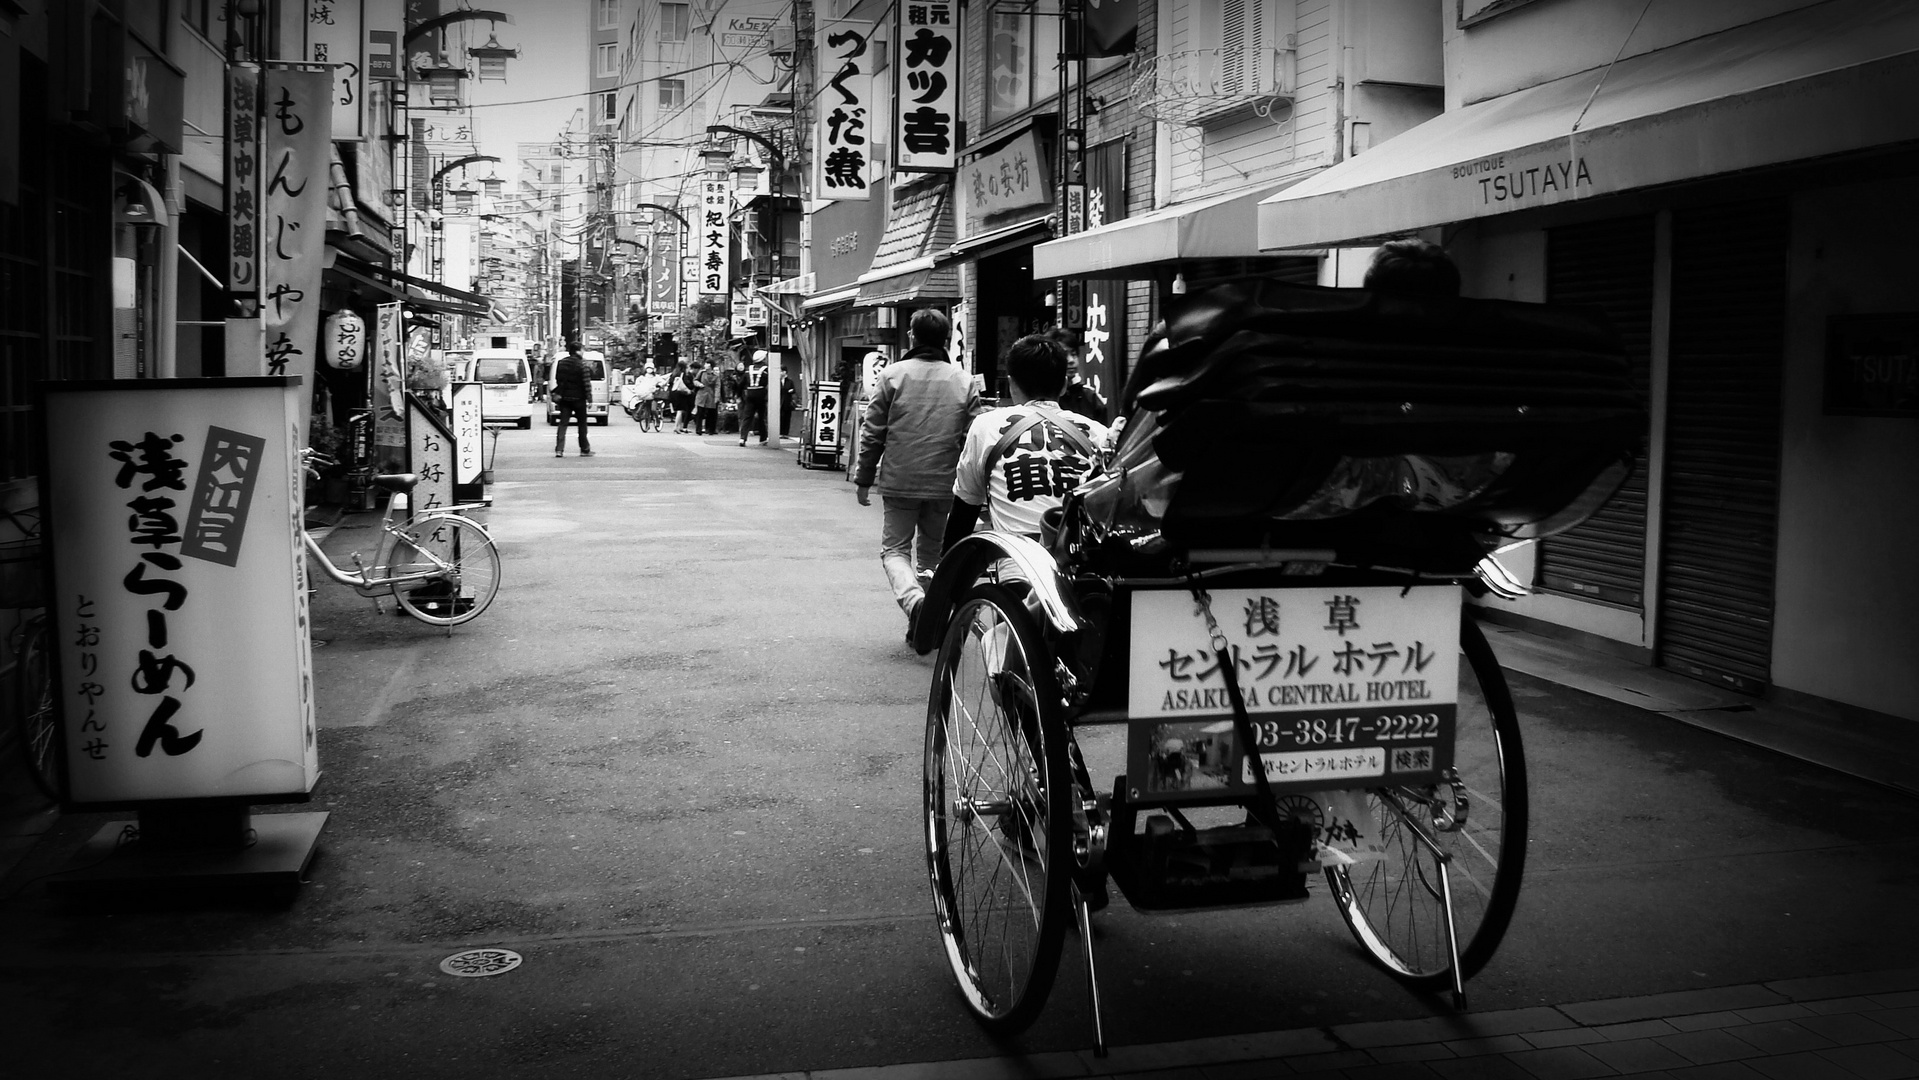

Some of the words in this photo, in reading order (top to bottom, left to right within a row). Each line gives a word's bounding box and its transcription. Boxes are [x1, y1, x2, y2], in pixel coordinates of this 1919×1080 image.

[824, 29, 867, 190] つくだ煮
[903, 28, 952, 156] カツ吉
[232, 77, 254, 286] 浅草中央通り
[1453, 156, 1505, 179] BOUTIQUE
[1478, 157, 1593, 204] TSUTAYA
[819, 395, 837, 442] カツ吉
[109, 431, 203, 758] 浅草らーめん
[1243, 595, 1360, 637] 浅草
[1162, 687, 1261, 711] ASAKUA
[1267, 682, 1360, 707] CENTRAL
[1365, 679, 1432, 702] HOTEL
